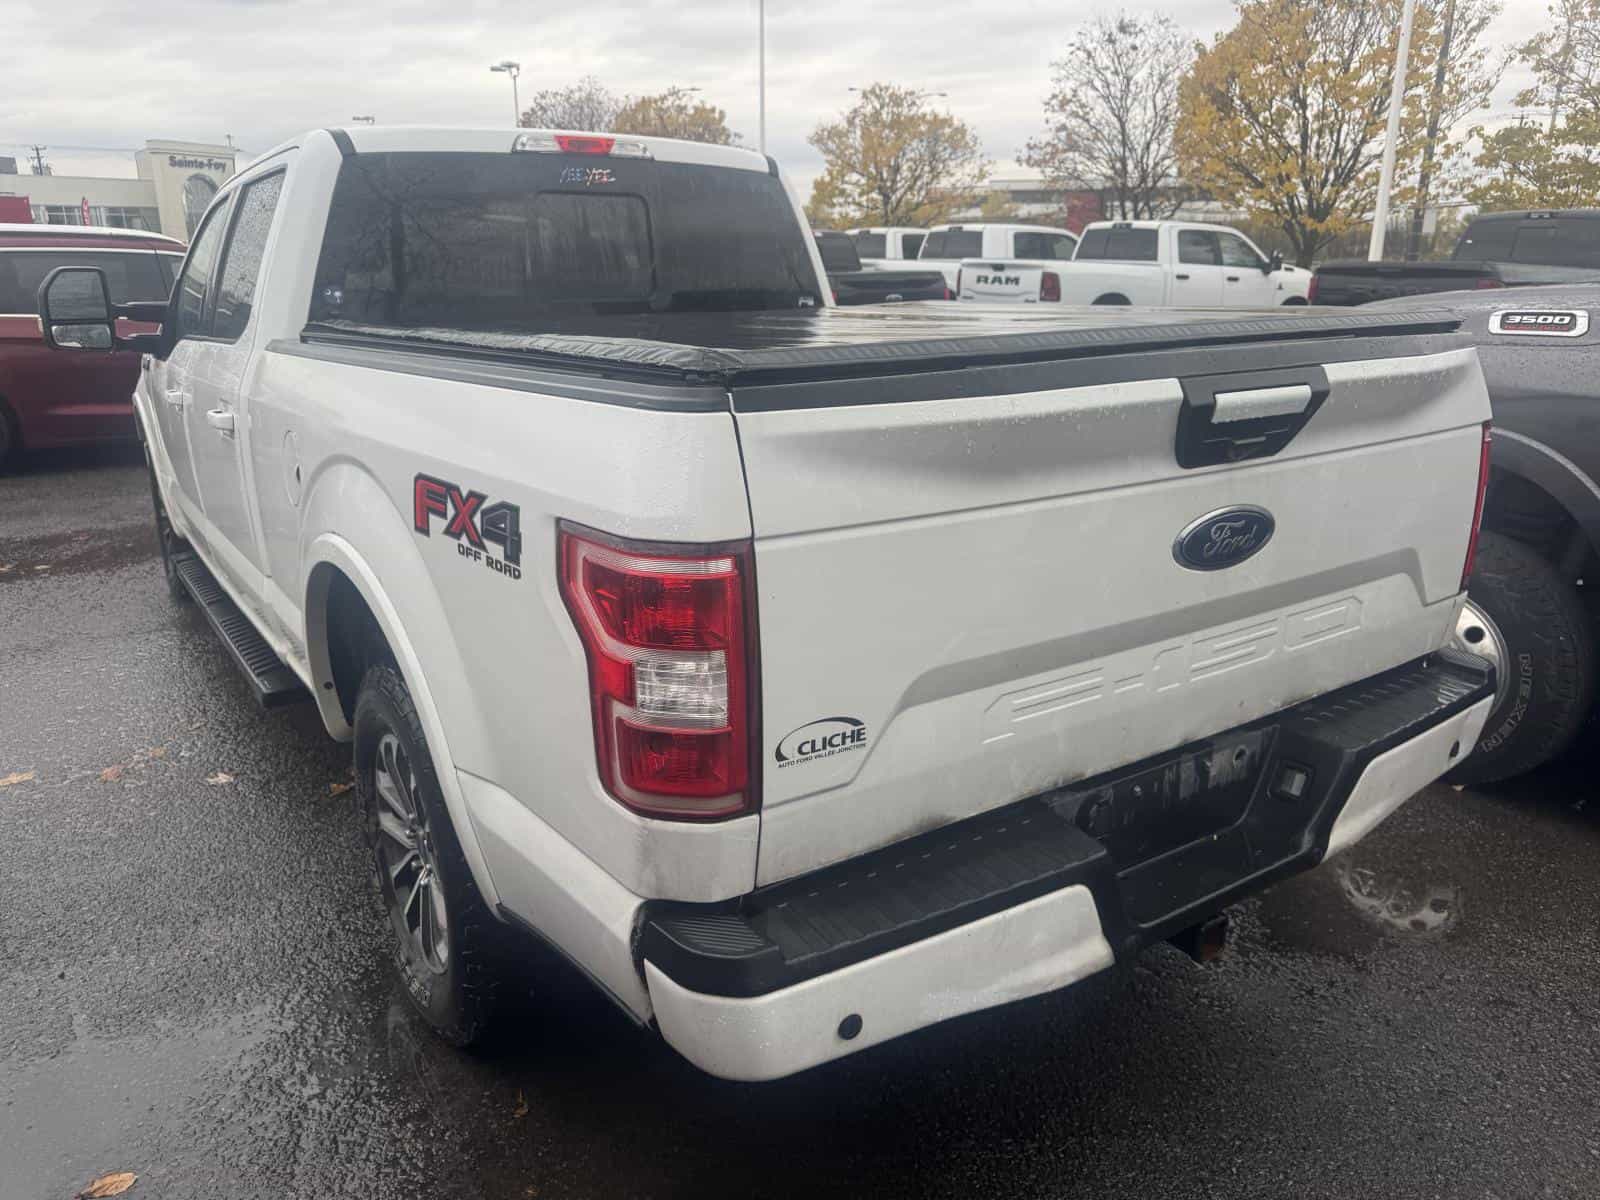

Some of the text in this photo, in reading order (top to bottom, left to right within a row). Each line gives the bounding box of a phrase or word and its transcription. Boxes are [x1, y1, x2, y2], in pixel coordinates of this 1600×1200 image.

[168, 155, 226, 172] Sainte-Foy
[976, 275, 1020, 286] RAM
[1504, 315, 1571, 324] 3500
[414, 471, 522, 567] FX4
[457, 542, 521, 580] OFF ROAD
[797, 727, 867, 755] CLICHE
